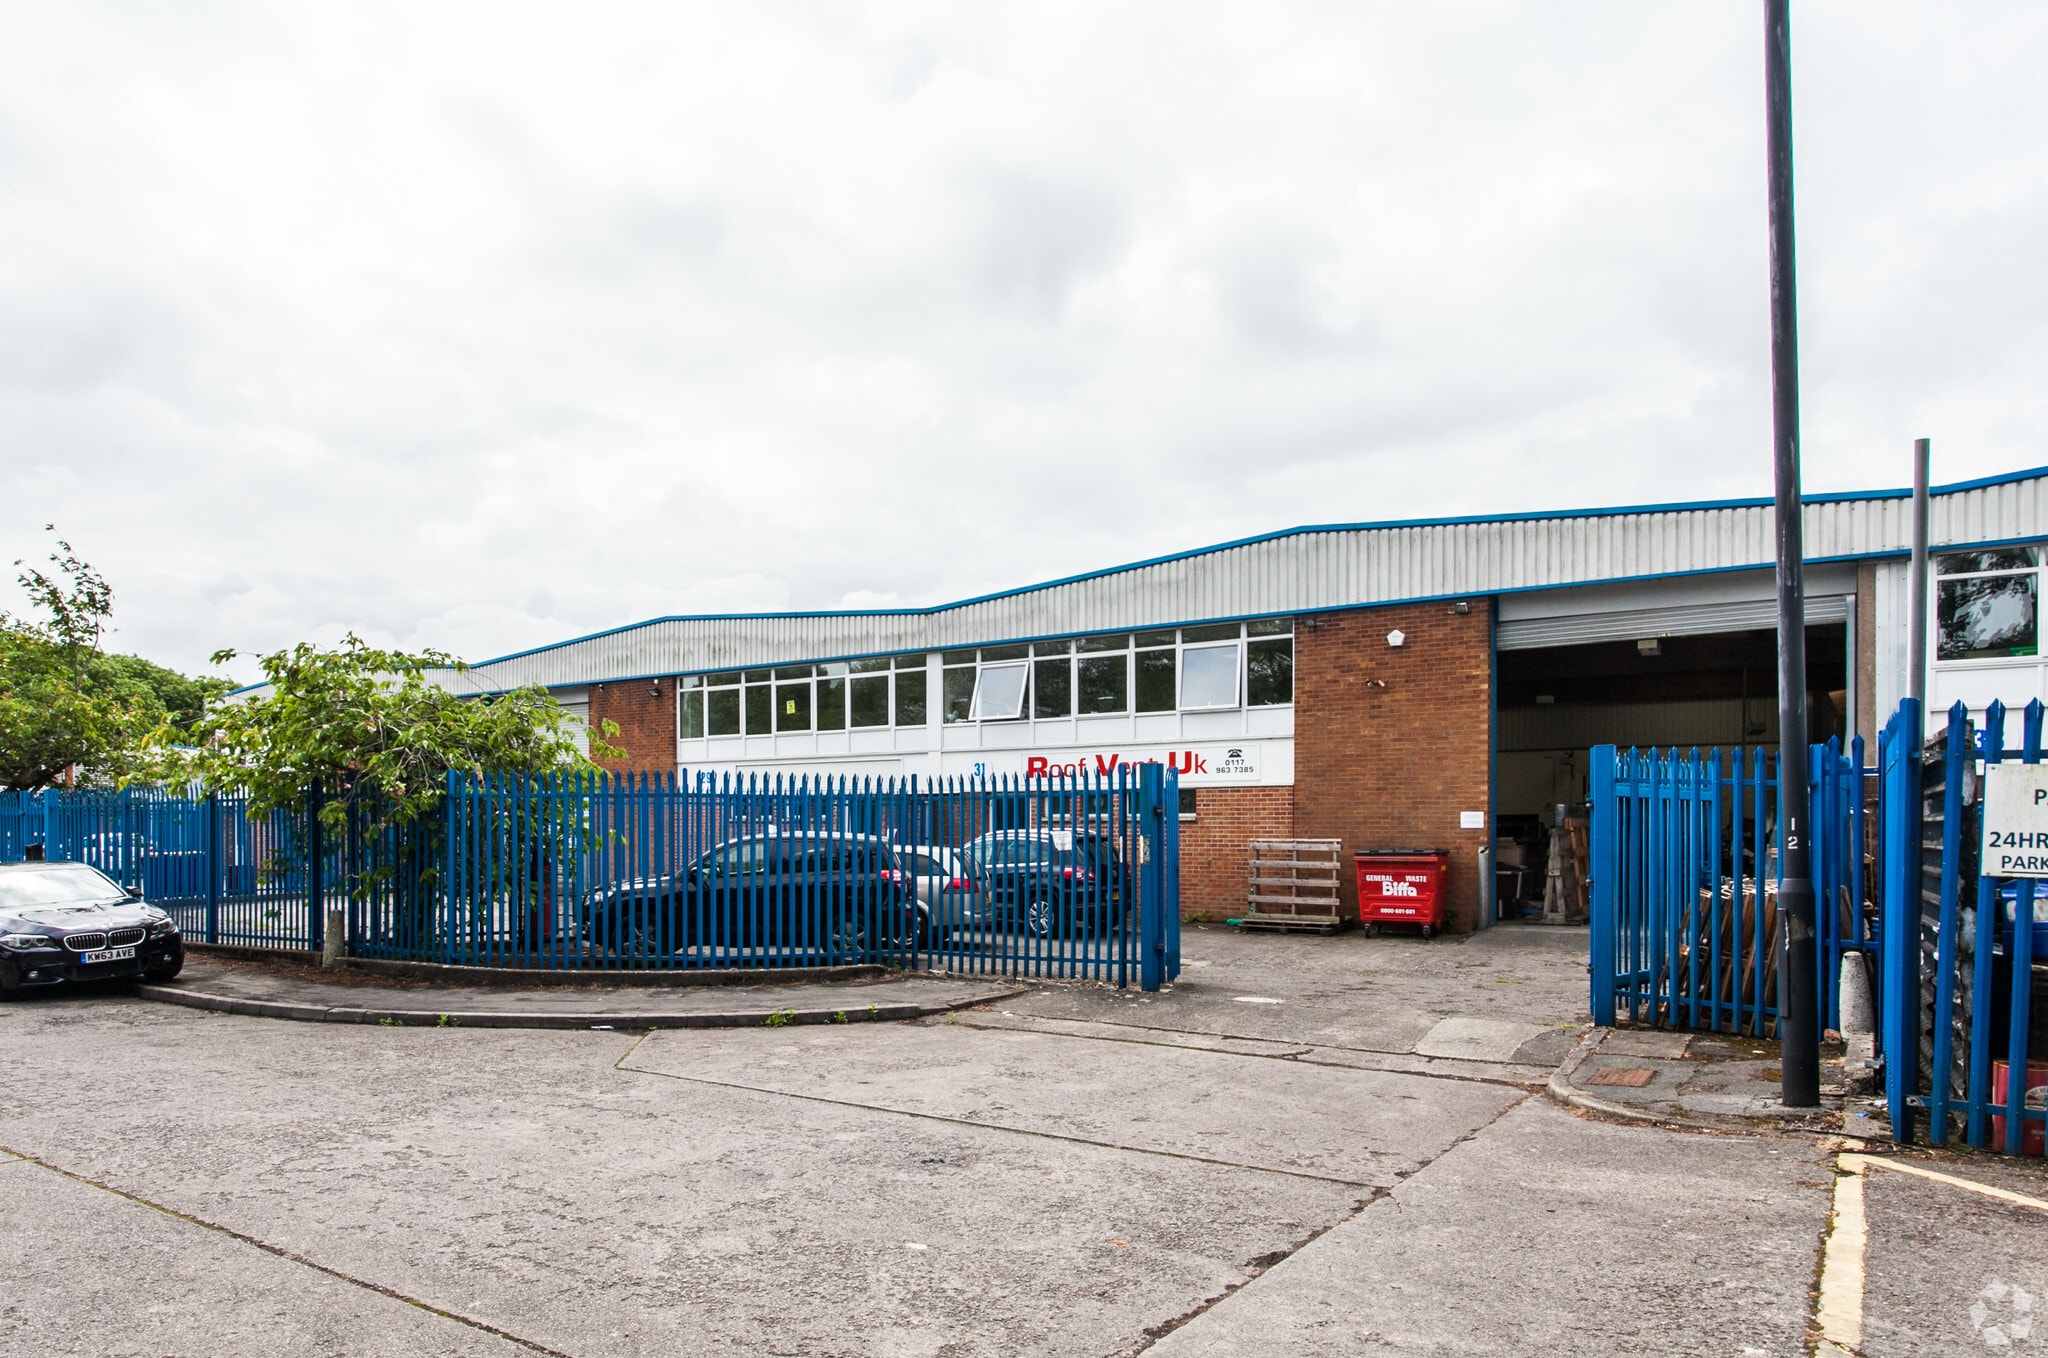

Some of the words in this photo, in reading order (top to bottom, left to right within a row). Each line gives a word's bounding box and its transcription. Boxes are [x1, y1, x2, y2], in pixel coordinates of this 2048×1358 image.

[974, 762, 985, 777] 31
[1028, 756, 1087, 778] Roof
[1095, 754, 1160, 777] Ve
[1169, 751, 1208, 774] Uk
[2034, 789, 2048, 805] P
[1989, 831, 2048, 849] 24HR
[2001, 855, 2048, 870] PARK
[1366, 874, 1393, 882] GENERAL
[1382, 881, 1417, 897] Biffa
[87, 951, 113, 962] KW63
[116, 948, 134, 958] AVE
